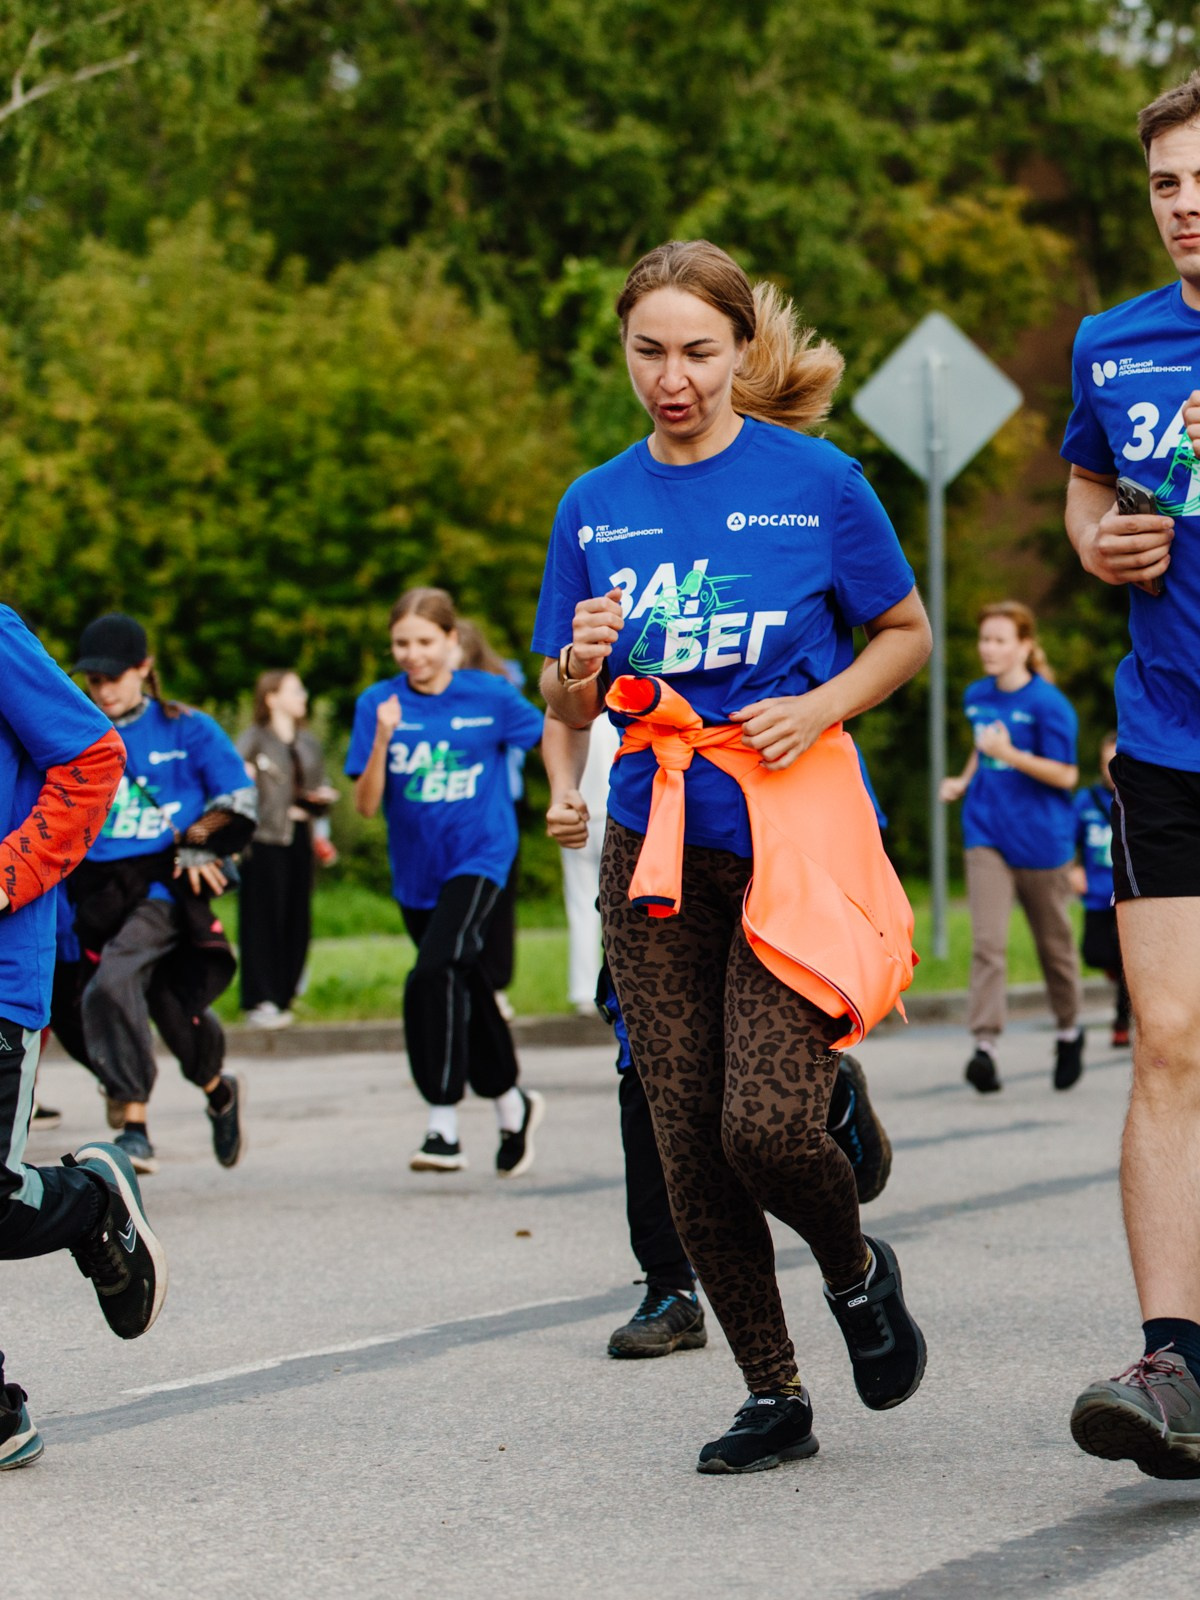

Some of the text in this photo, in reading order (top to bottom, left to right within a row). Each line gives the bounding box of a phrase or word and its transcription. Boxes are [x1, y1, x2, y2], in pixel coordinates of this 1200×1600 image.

[1118, 366, 1192, 377] ПРОМЫШЛЕННОСТИ
[1119, 360, 1153, 371] АТОМНОЙ
[1122, 400, 1194, 461] ЗА
[595, 524, 609, 532] ЛЕТ
[748, 514, 819, 528] РОСАТОМ
[595, 526, 628, 537] АТОМНОЙ
[595, 528, 663, 543] ПРОМЫШЛЕННОСТИ
[662, 610, 788, 674] БЕГ
[389, 741, 449, 775] ЗА!
[33, 811, 52, 840] FILA
[4, 864, 16, 896] FILA
